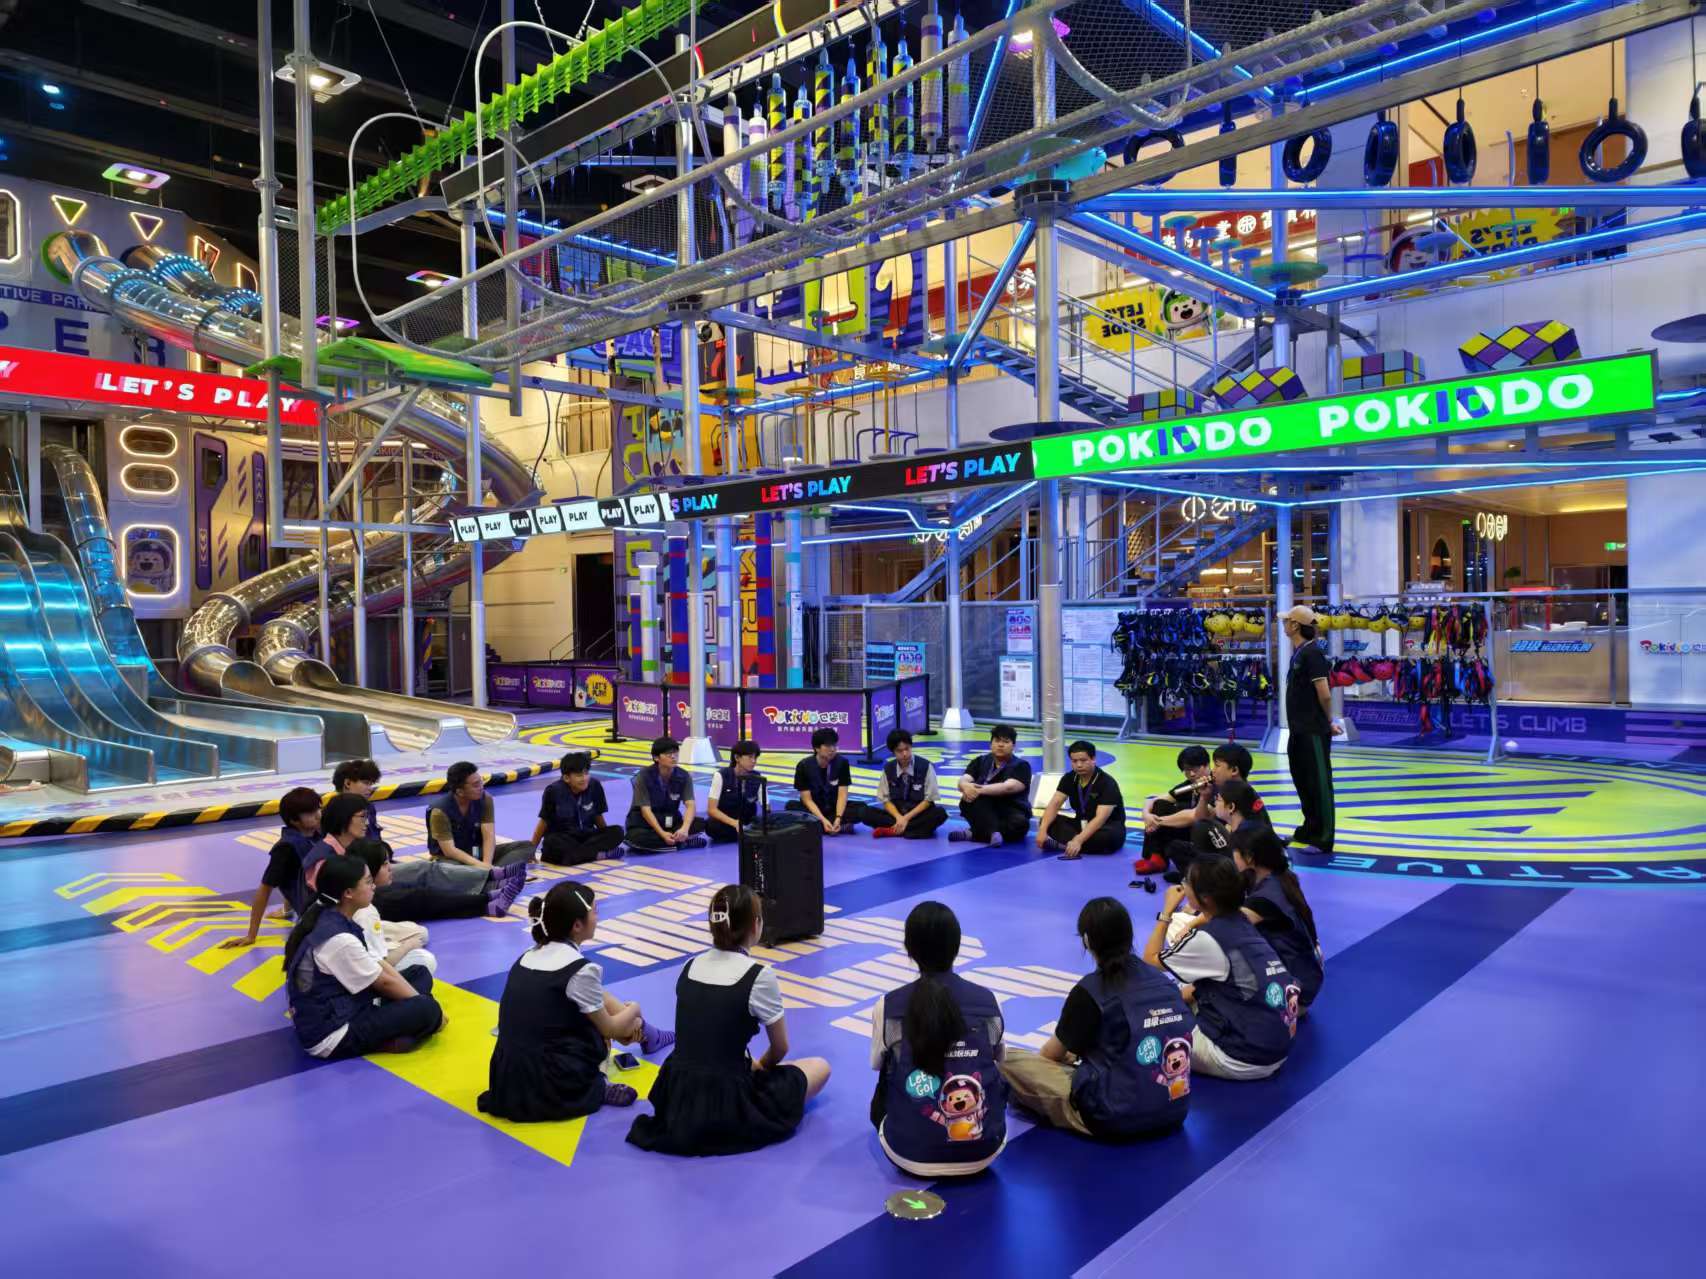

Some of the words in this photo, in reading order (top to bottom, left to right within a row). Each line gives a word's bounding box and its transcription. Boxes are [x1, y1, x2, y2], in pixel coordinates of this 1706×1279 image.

[52, 294, 96, 311] PAR
[97, 372, 194, 400] LET'S
[213, 387, 302, 412] PLAY
[1072, 417, 1272, 467] POKIDDO
[1319, 374, 1594, 438] POKIDDO
[683, 494, 718, 511] PLAY
[761, 482, 803, 503] LET'S
[808, 476, 851, 497] PLAY
[905, 460, 958, 486] LET'S
[964, 452, 1021, 479] PLAY
[460, 525, 476, 534] PLAY
[485, 521, 501, 531] PLAY
[512, 517, 530, 529] PLAY
[539, 515, 557, 526] PLAY
[569, 512, 588, 522] PLAY
[601, 507, 622, 519] PLAY
[634, 504, 655, 515] PLAY
[1450, 712, 1510, 729] LETS
[1519, 714, 1587, 734] CLIMB
[1328, 855, 1706, 880] ACTIVE
